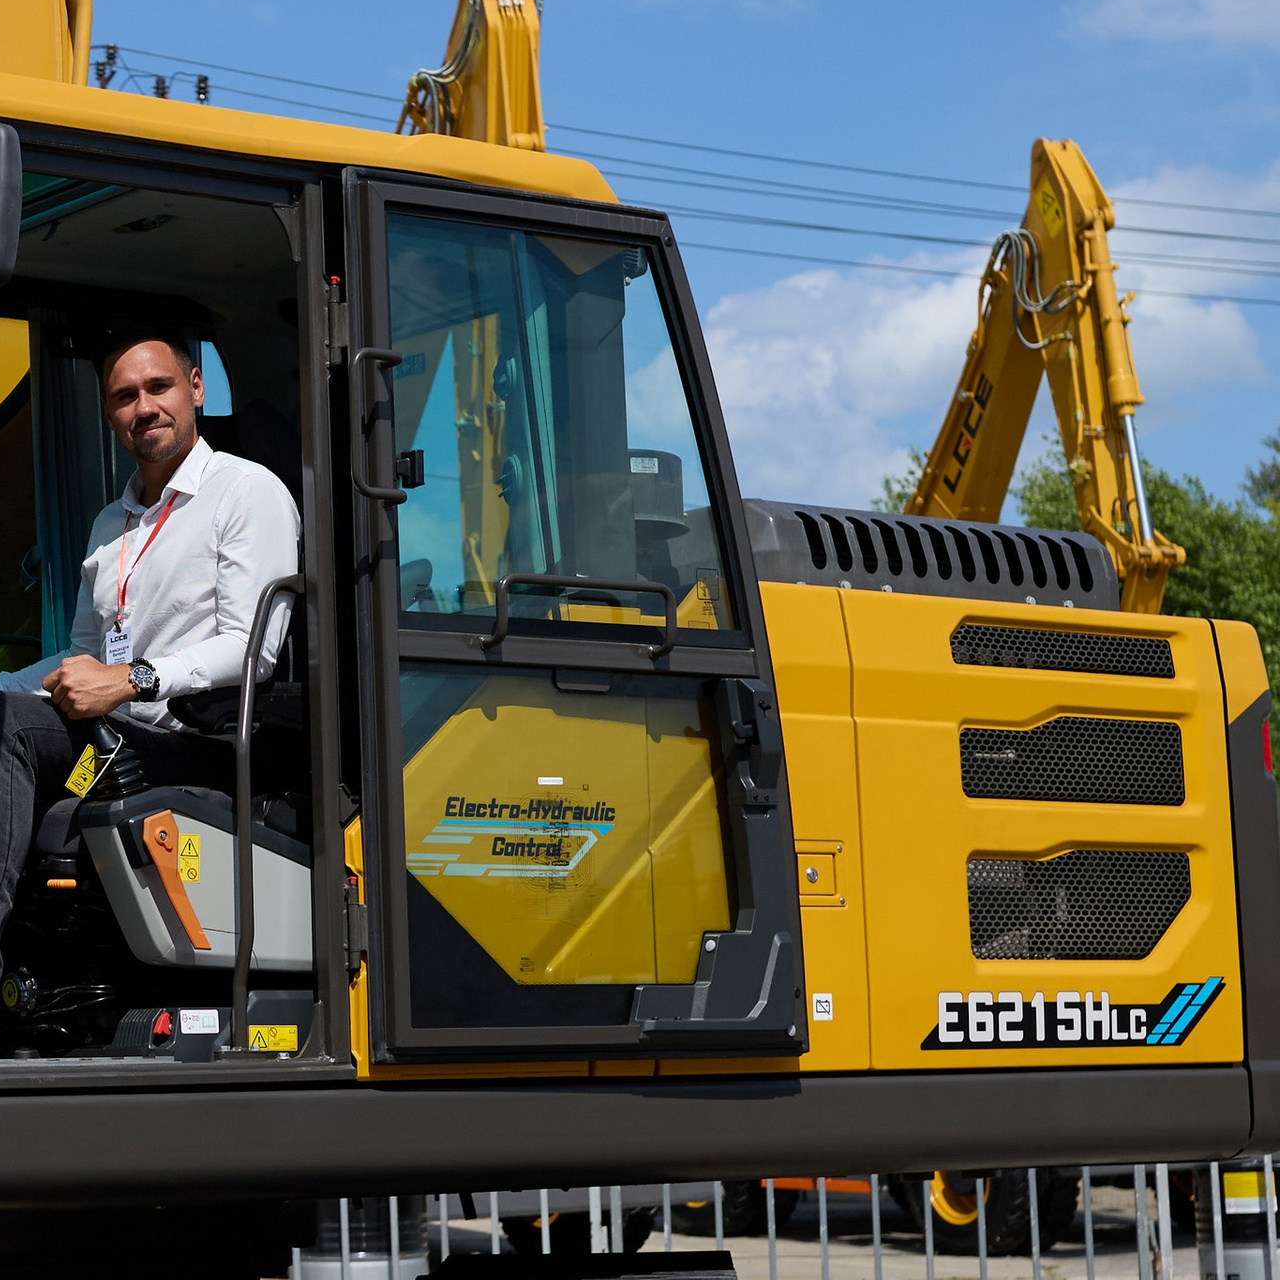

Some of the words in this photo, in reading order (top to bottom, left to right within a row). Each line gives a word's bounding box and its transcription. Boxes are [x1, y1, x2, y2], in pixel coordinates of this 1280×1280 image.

[445, 795, 616, 822] Electro-Hydraulic
[490, 836, 562, 859] Control
[937, 991, 1147, 1043] E6215HLC
